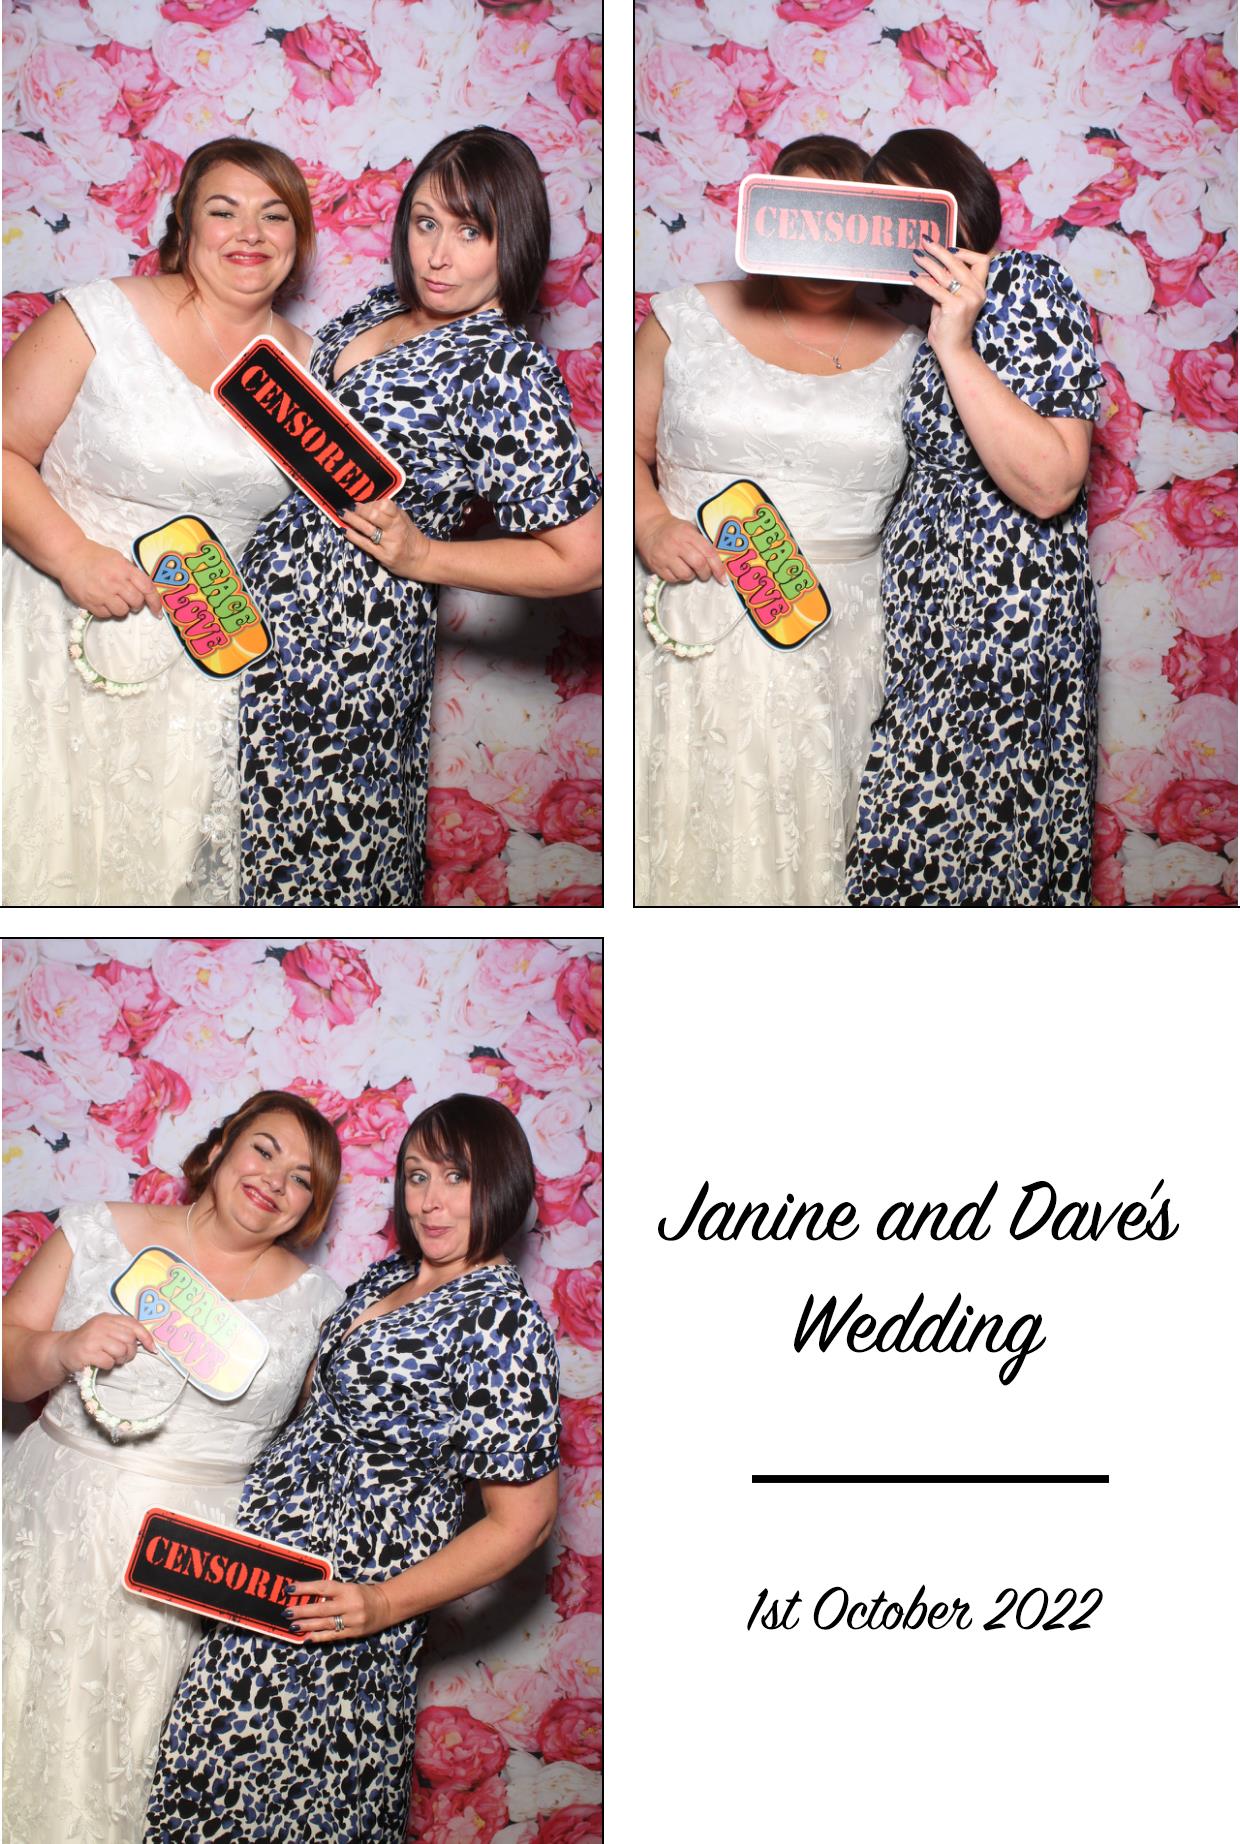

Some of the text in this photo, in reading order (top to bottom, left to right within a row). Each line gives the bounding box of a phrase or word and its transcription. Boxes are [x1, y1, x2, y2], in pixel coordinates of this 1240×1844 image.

[240, 365, 376, 502] CENSORED
[185, 543, 258, 634] PEACE
[727, 549, 790, 626] LOVE
[743, 506, 815, 601] PEACE
[163, 584, 229, 655] LOVE
[153, 1311, 226, 1379] LOVE
[159, 1267, 243, 1349] PEACE
